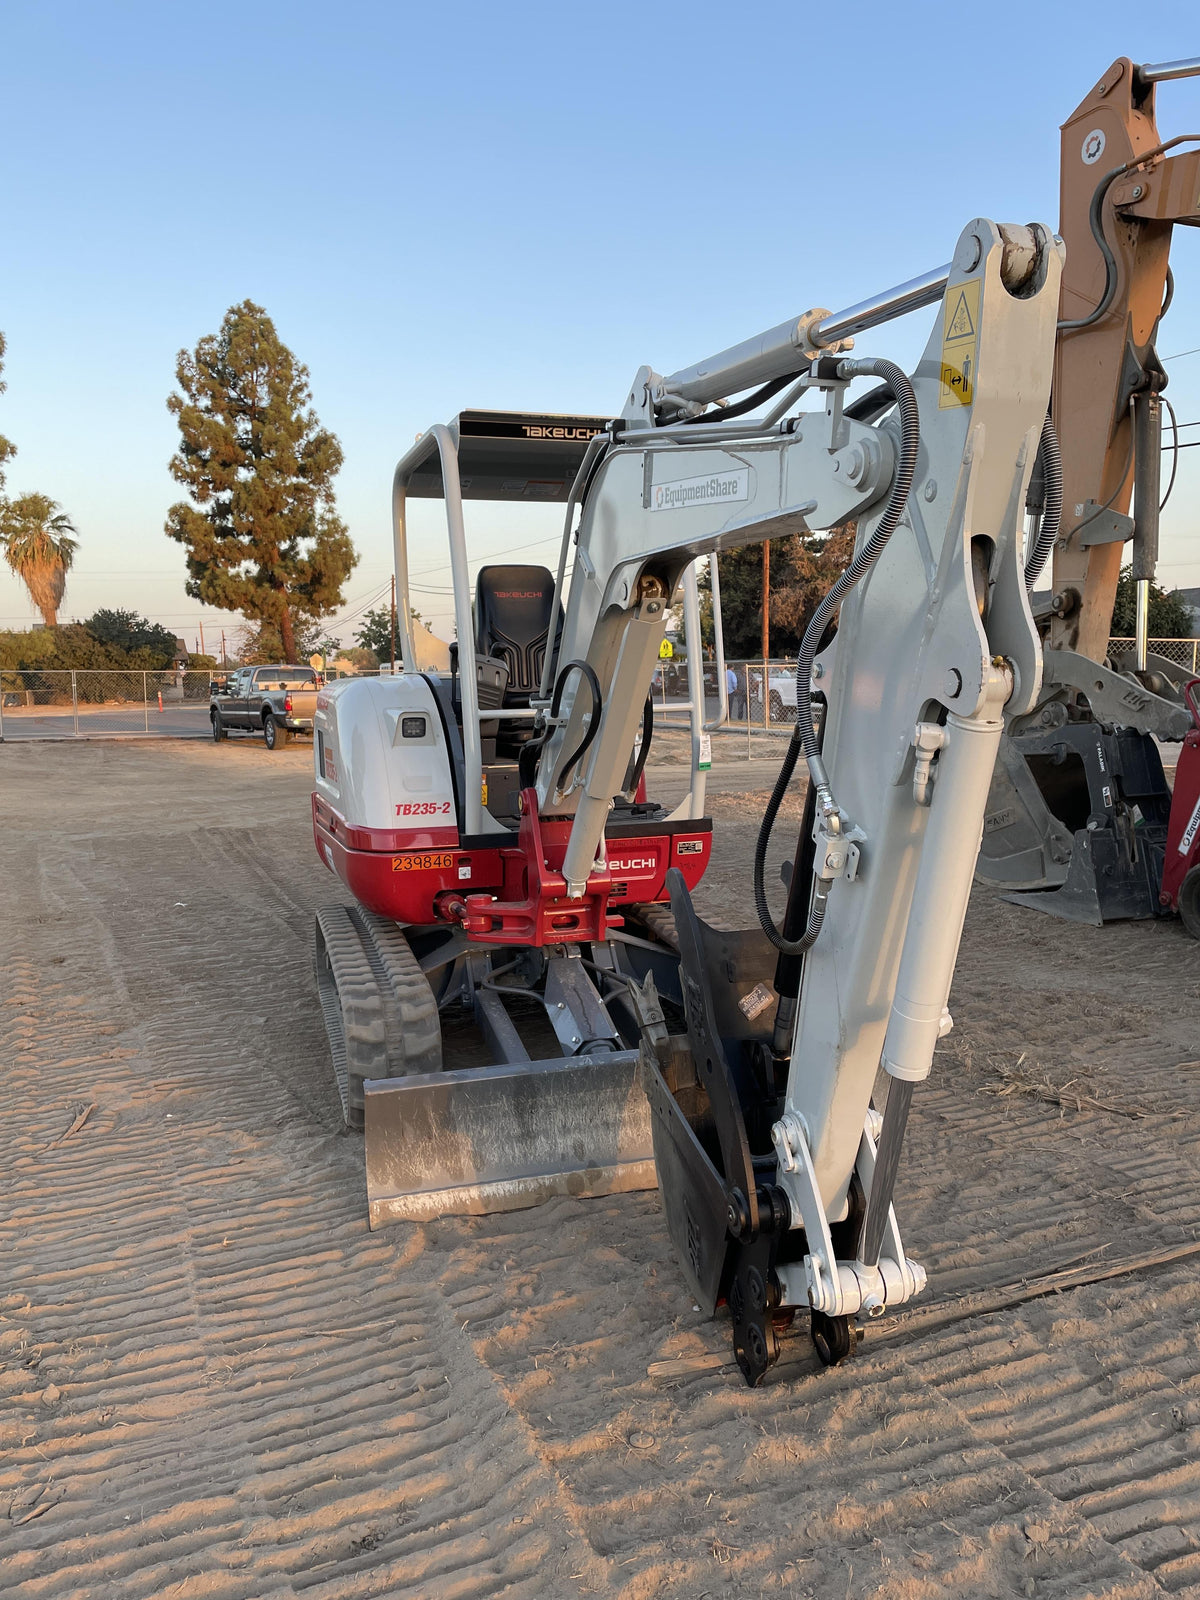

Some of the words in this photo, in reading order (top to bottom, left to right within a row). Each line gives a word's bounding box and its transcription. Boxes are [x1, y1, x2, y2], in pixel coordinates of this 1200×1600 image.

[664, 478, 738, 506] EquipmentShare
[395, 801, 451, 816] TB235-2
[394, 854, 452, 871] 239846
[609, 858, 655, 870] EUCHI
